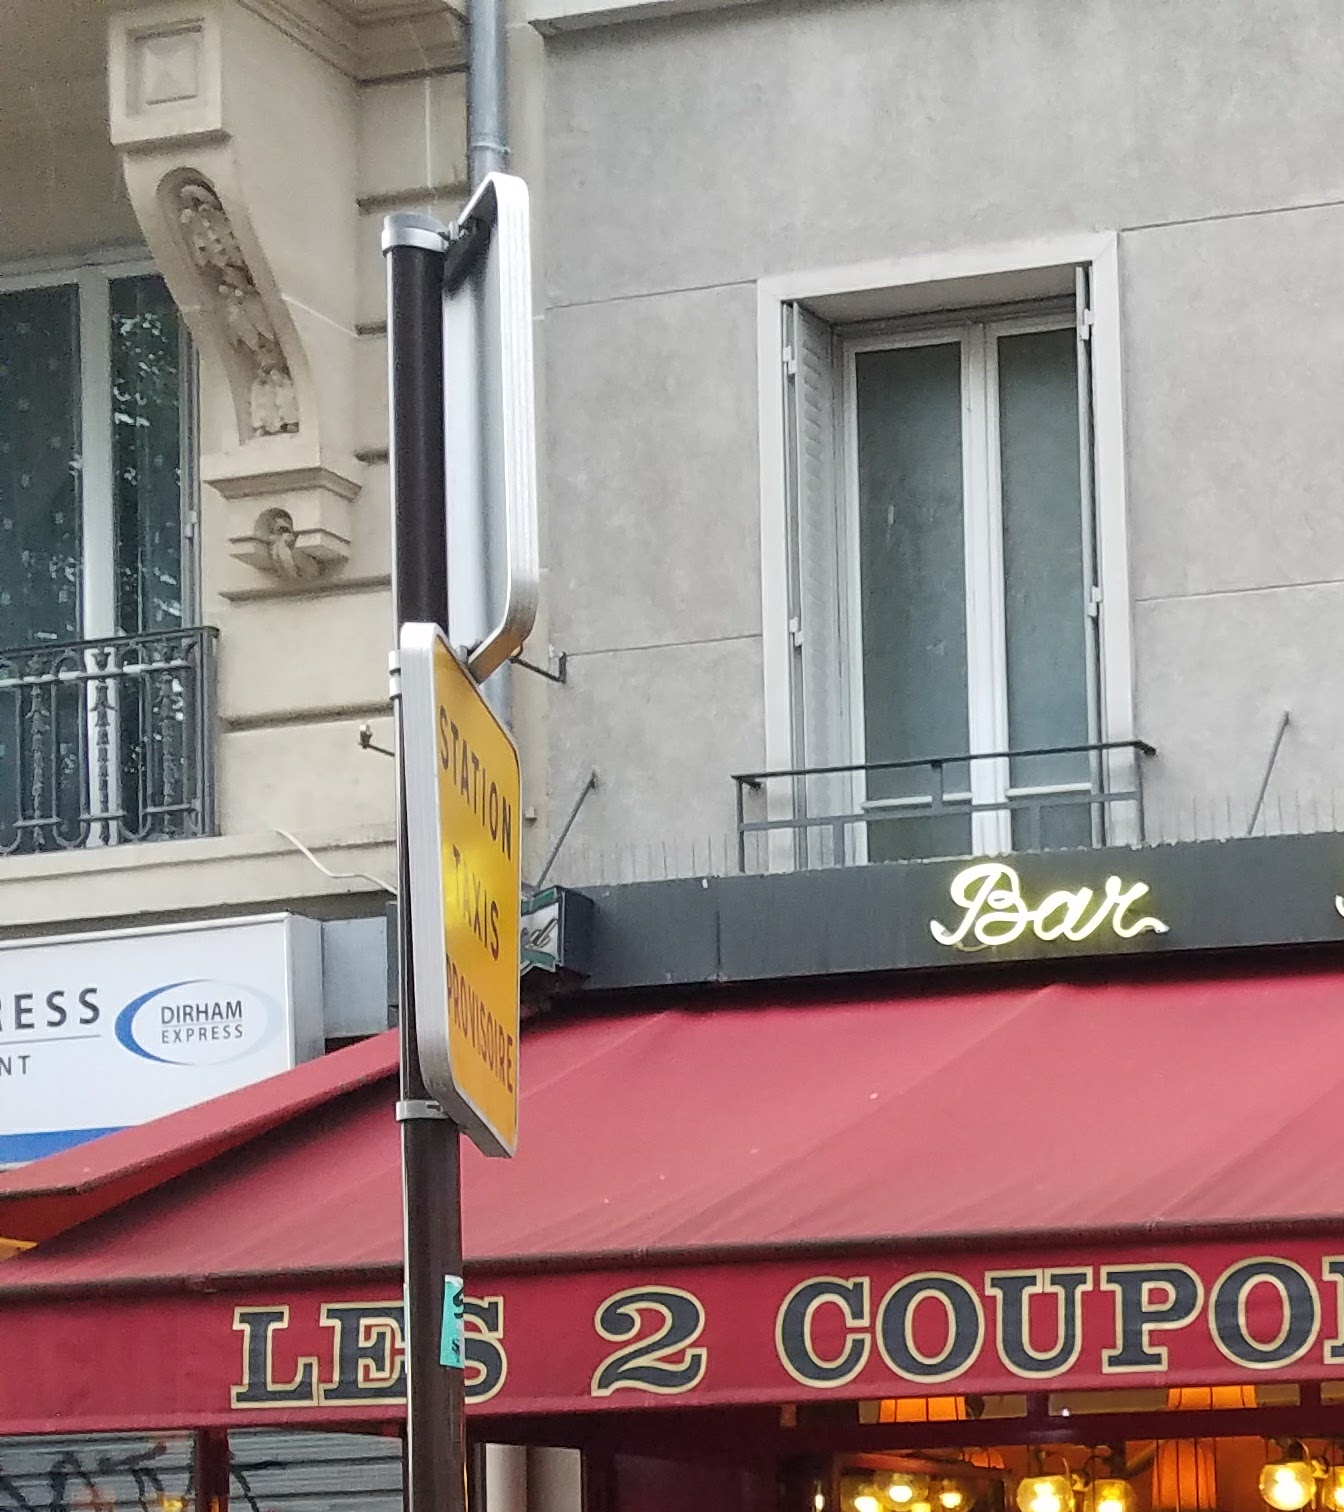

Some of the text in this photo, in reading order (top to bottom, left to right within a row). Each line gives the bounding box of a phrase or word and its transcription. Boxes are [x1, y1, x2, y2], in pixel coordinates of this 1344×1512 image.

[439, 703, 512, 862] STATION
[452, 843, 501, 963] TAXIS
[930, 862, 1170, 952] Bar
[0, 987, 101, 1032] ESS
[160, 1000, 243, 1025] DIRHAM
[161, 1024, 243, 1044] EXPRESS
[446, 952, 514, 1095] PROVISOIRE
[589, 1283, 708, 1398] 2
